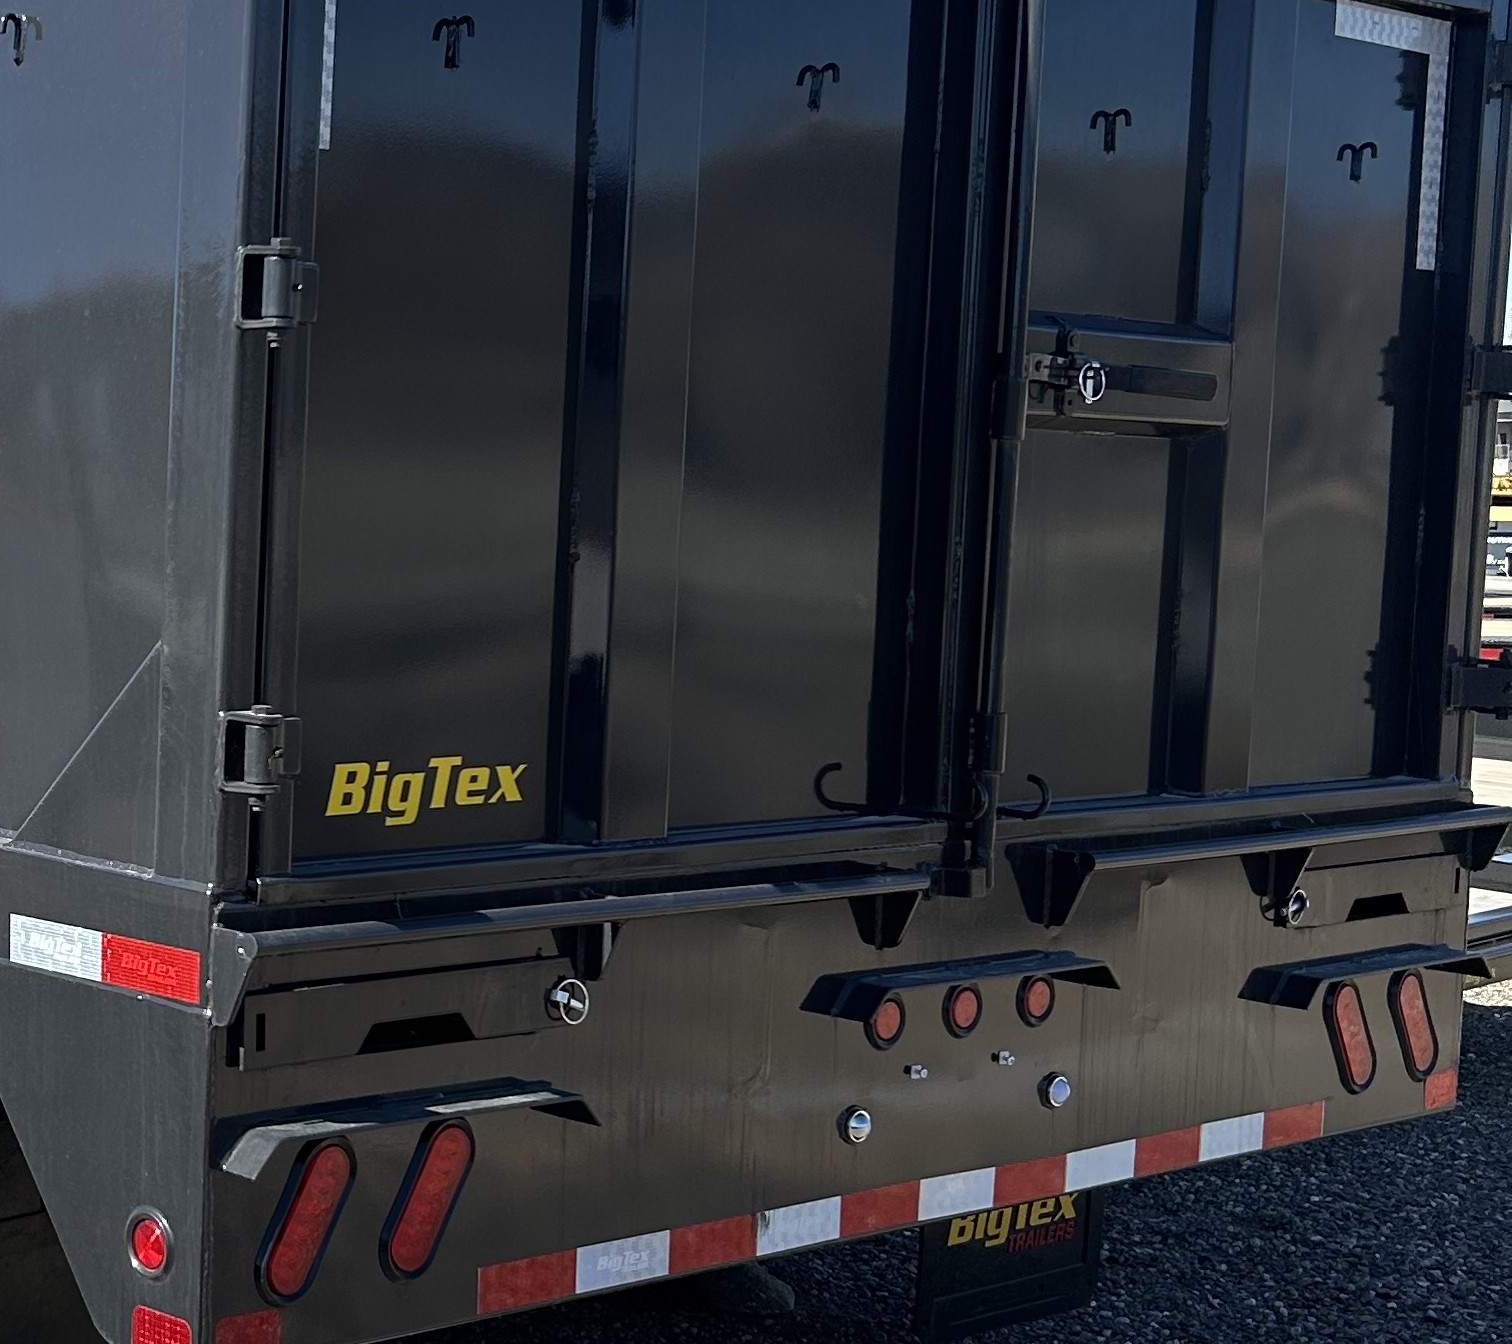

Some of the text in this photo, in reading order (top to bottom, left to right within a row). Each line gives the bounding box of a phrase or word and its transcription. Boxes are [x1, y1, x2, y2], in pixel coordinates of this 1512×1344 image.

[324, 756, 528, 827] BigTex
[120, 951, 179, 978] BigTex
[1008, 1222, 1076, 1253] TRAILERS
[596, 1250, 650, 1272] BigTex
